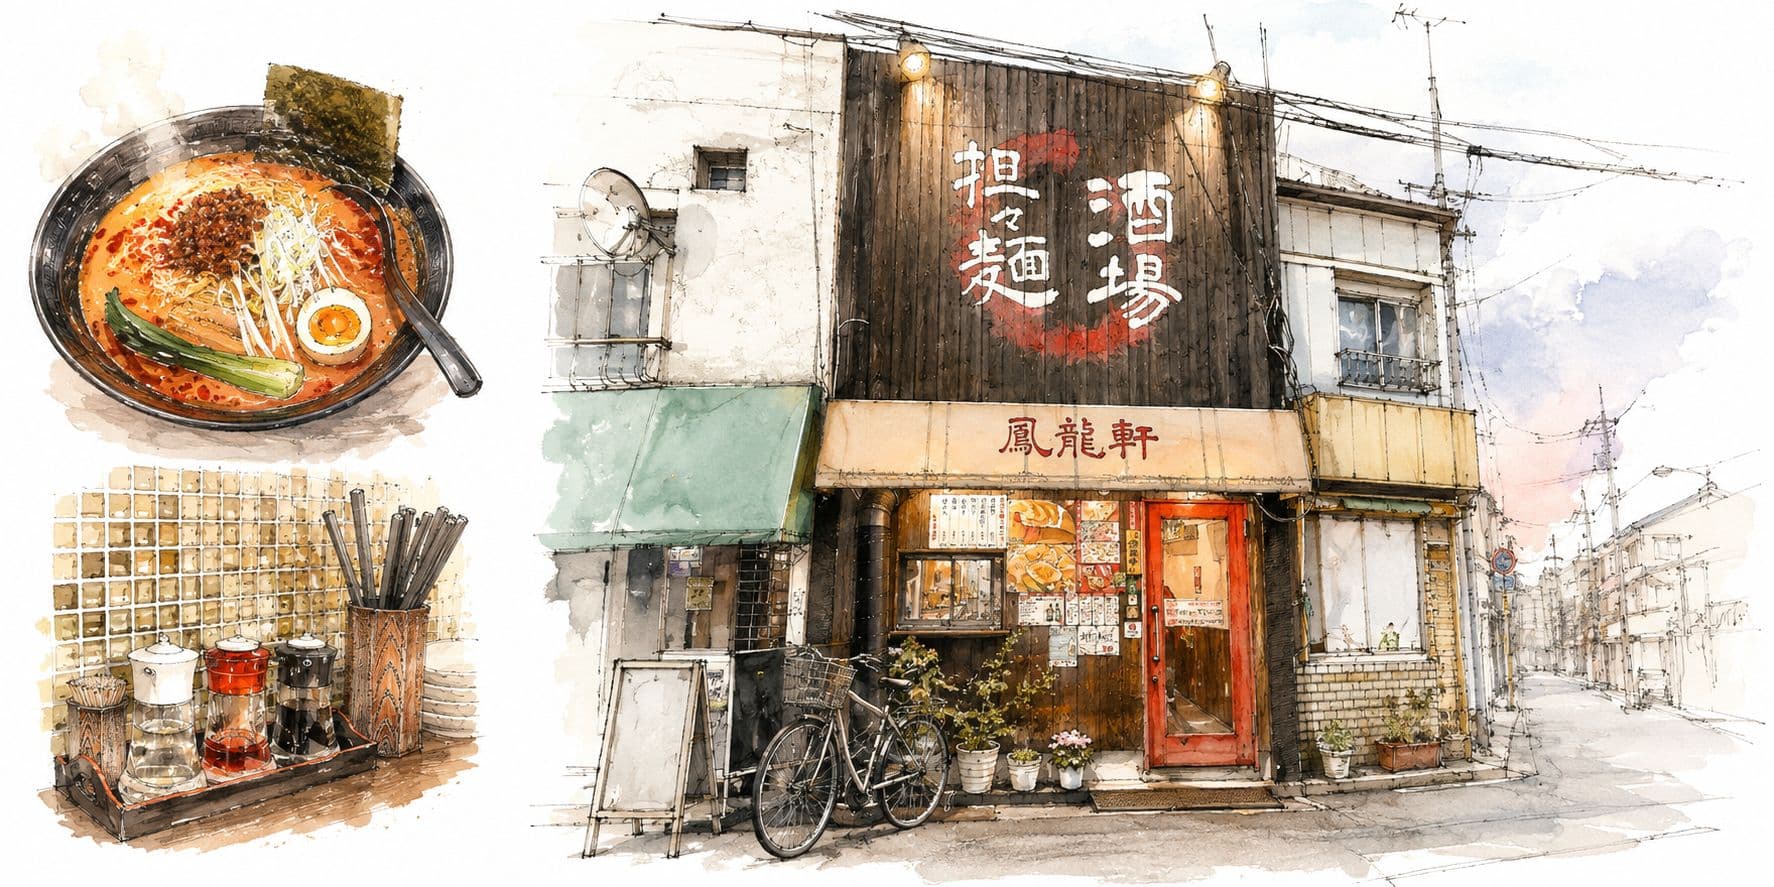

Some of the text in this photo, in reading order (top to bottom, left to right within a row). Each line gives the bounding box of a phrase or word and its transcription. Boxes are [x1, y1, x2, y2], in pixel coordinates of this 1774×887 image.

[952, 139, 1060, 308] 担々麺
[1086, 169, 1183, 329] 酒場
[998, 416, 1159, 460] 鳳龍軒
